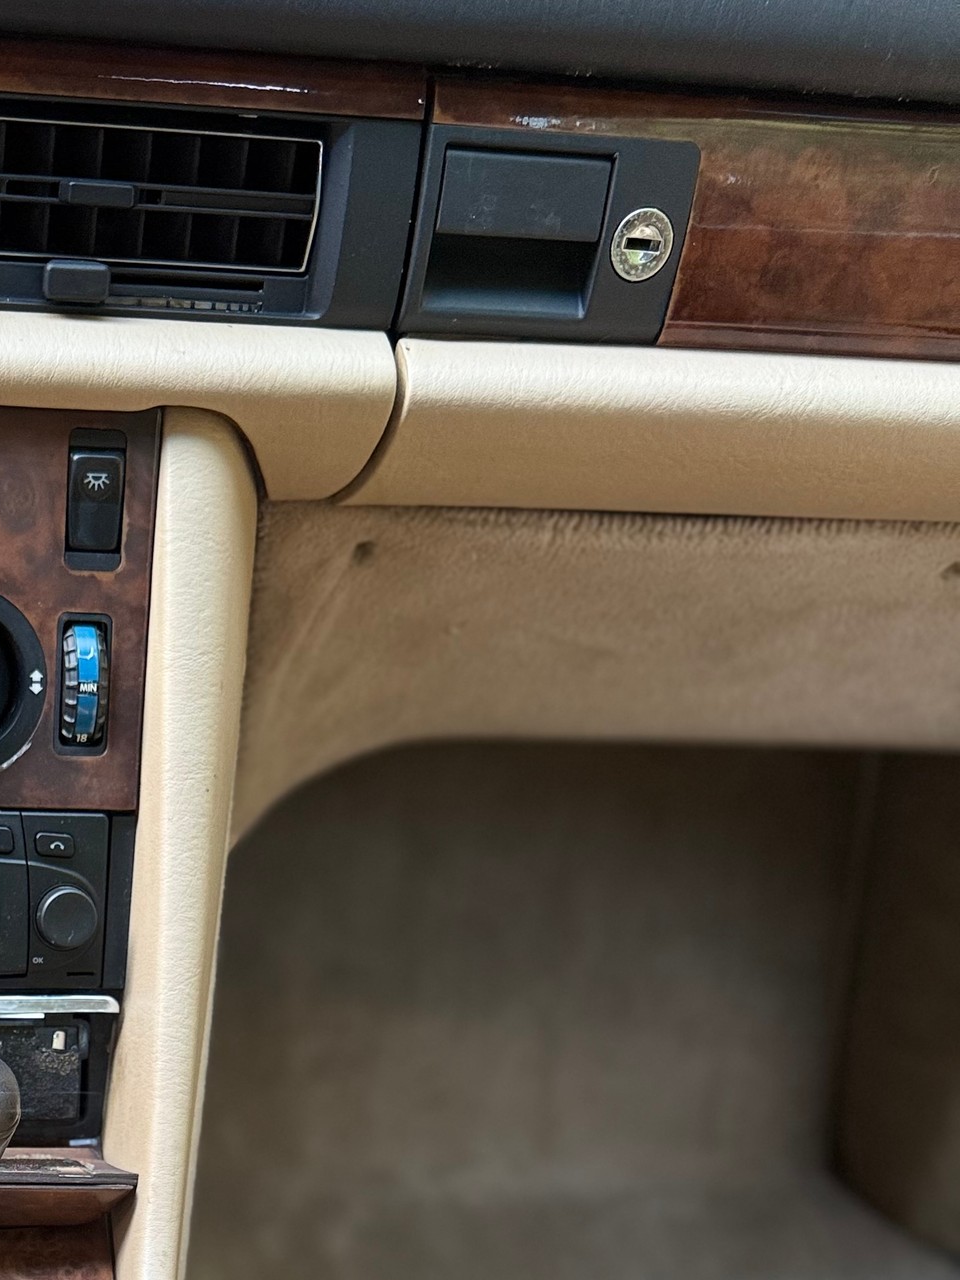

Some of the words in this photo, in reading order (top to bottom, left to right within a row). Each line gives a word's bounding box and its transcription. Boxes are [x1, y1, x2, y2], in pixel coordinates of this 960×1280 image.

[79, 682, 98, 694] MIN
[76, 733, 88, 743] 18
[32, 956, 44, 964] OK
